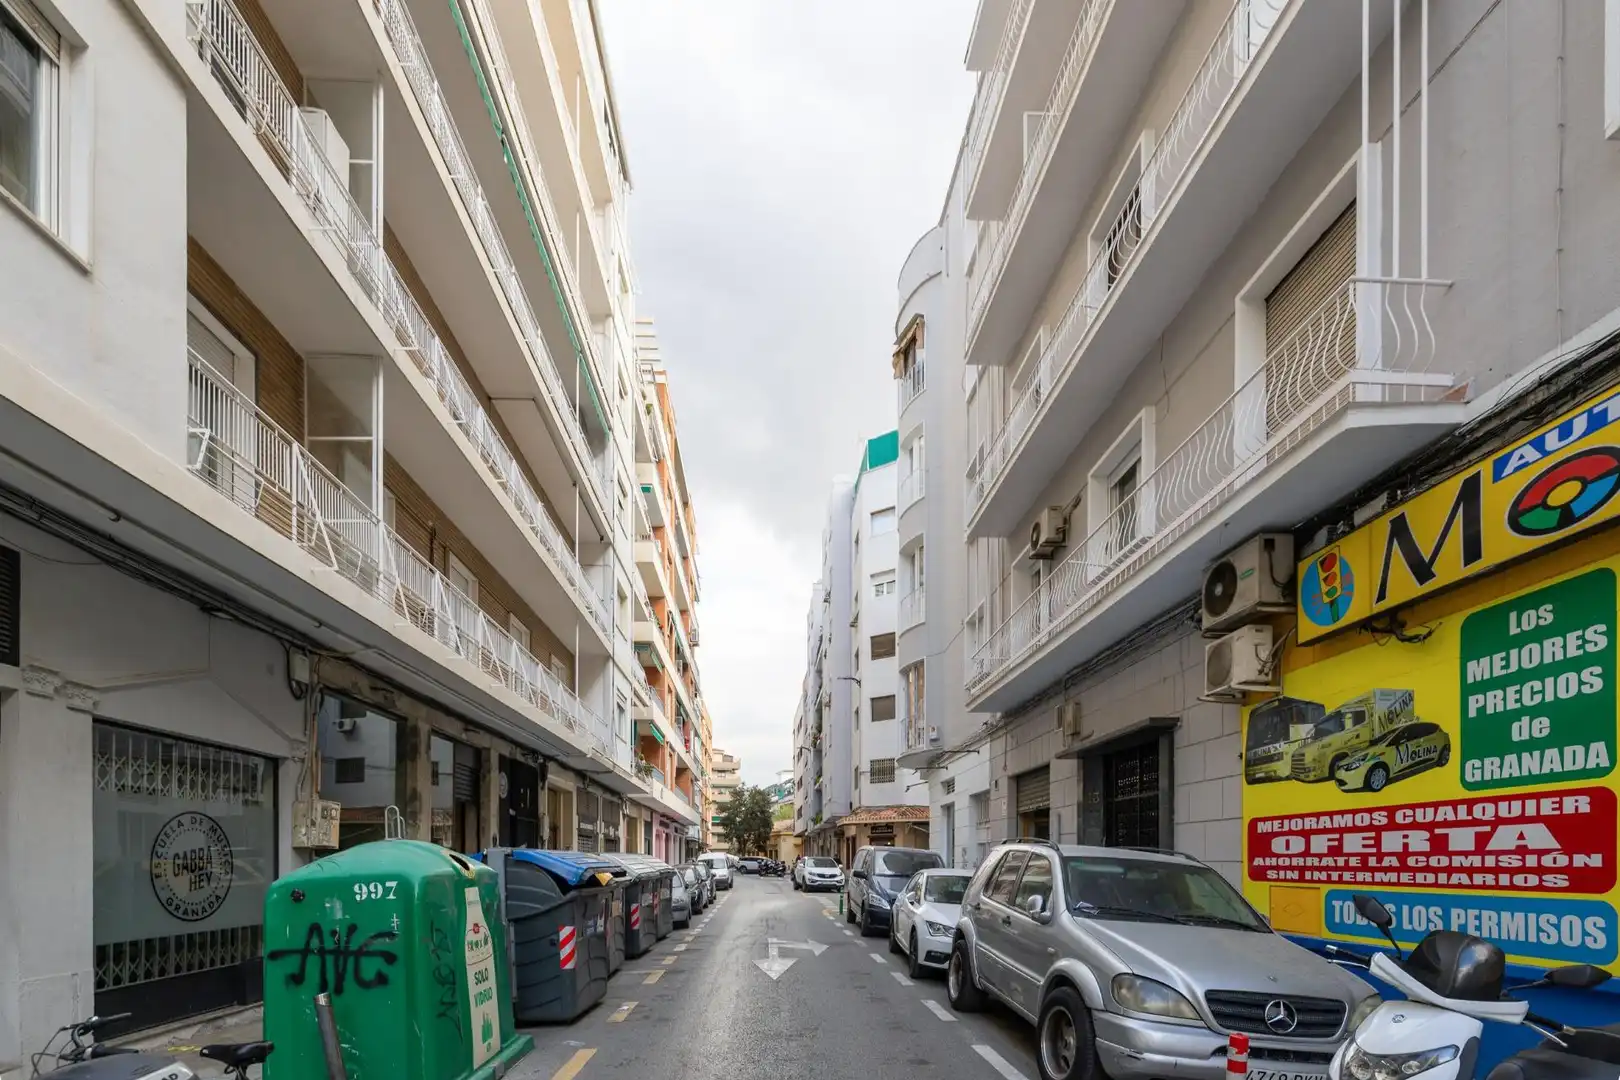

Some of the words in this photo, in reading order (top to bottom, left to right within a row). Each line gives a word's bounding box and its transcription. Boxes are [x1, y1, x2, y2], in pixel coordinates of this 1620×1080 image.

[1509, 604, 1554, 636] LOS
[1466, 623, 1608, 684] MEJORES
[1468, 666, 1604, 718] PRECIOS
[1511, 716, 1550, 742] de
[1464, 741, 1610, 782] GRANADA
[1257, 811, 1388, 834] MEJORAMOS
[1395, 795, 1591, 824] CUALQUIER
[154, 819, 185, 879] ESCUELA
[190, 816, 204, 826] DE
[1270, 823, 1562, 855] OFERTA
[173, 845, 213, 878] GABBA
[1253, 856, 1361, 867] AHORRATE
[1368, 856, 1400, 867] LA
[1406, 851, 1603, 868] COMISIÓN
[189, 871, 213, 892] HEY
[353, 881, 398, 901] 997
[1266, 870, 1300, 880] SIN
[1305, 871, 1570, 888] INTERMEDIARIOS
[166, 894, 222, 917] GRANADA
[1332, 900, 1397, 929] TOS
[1402, 904, 1444, 932] LOS
[1450, 907, 1608, 950] PERMISOS
[474, 967, 489, 986] SOLO
